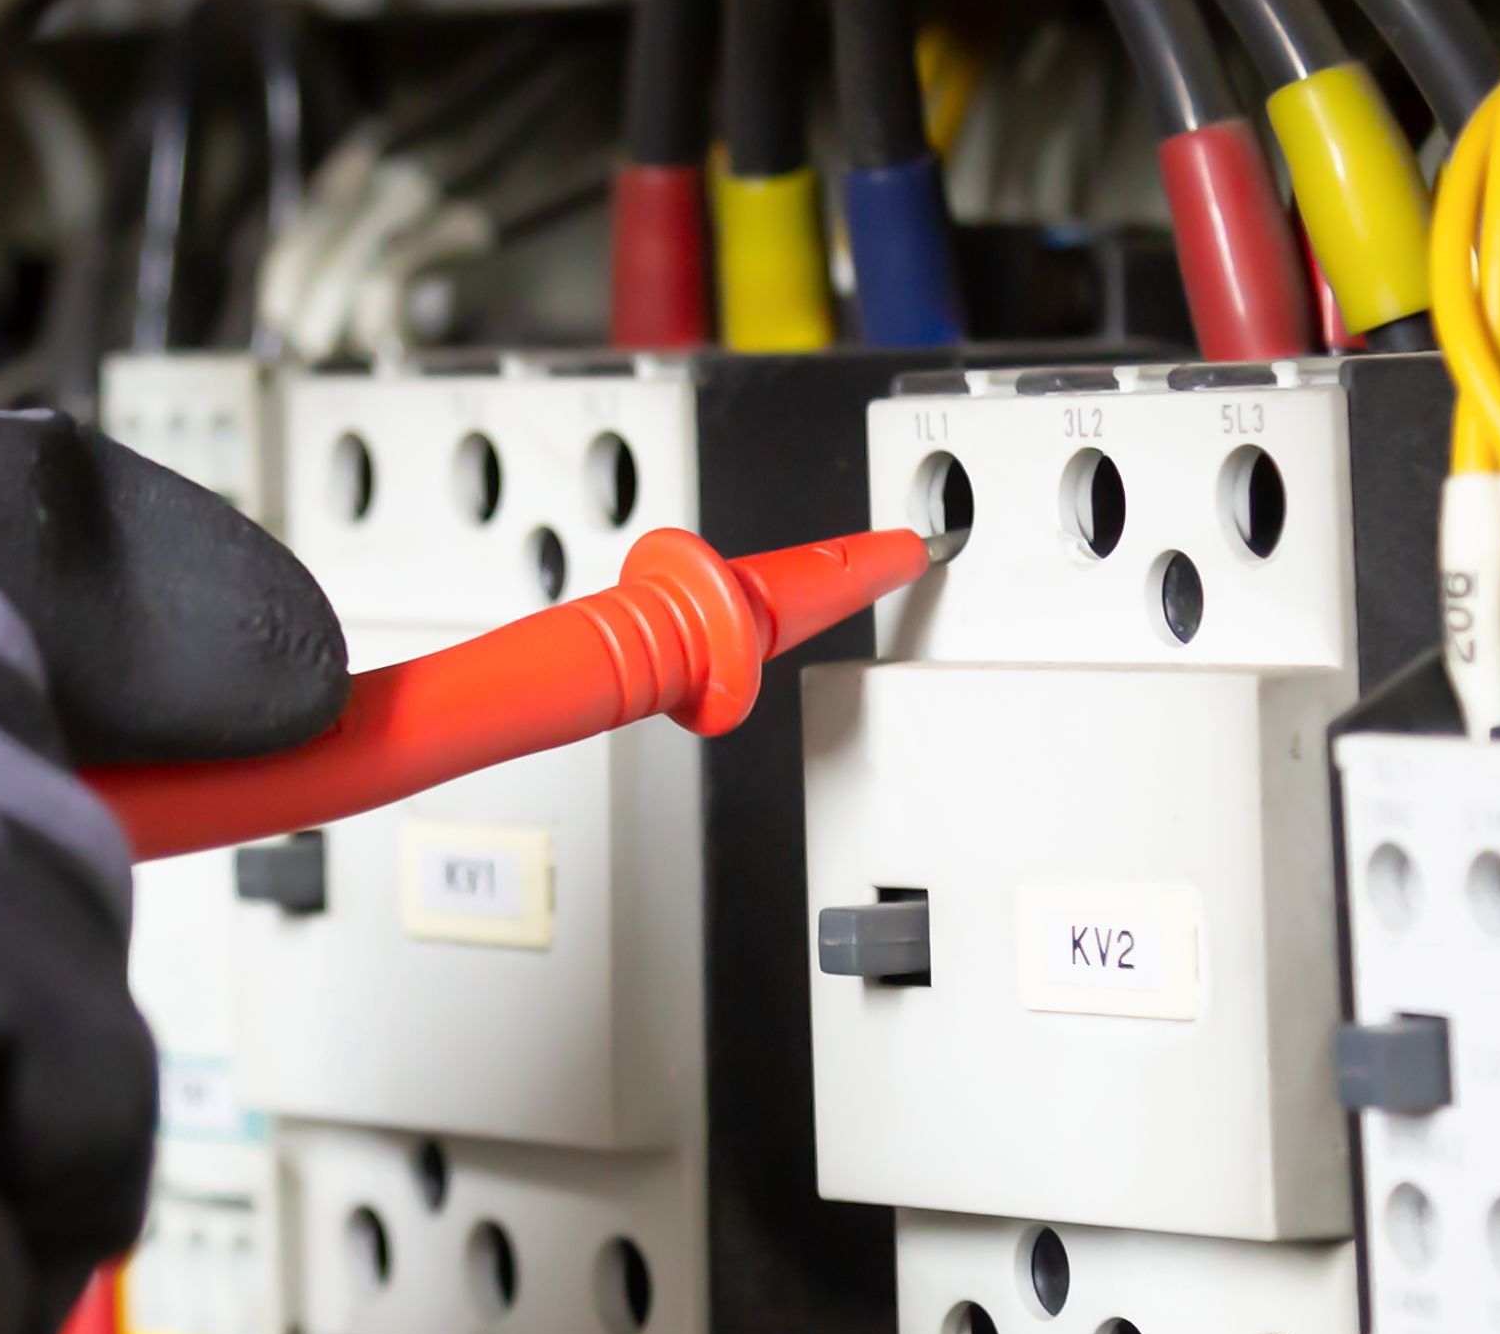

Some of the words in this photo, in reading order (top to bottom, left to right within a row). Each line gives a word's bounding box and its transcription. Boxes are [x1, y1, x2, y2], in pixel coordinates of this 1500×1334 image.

[915, 412, 949, 441] 1L1
[1063, 408, 1104, 439] 3L2
[1221, 404, 1265, 434] 5L3
[444, 857, 496, 899] KV1
[1071, 925, 1135, 970] KV2
